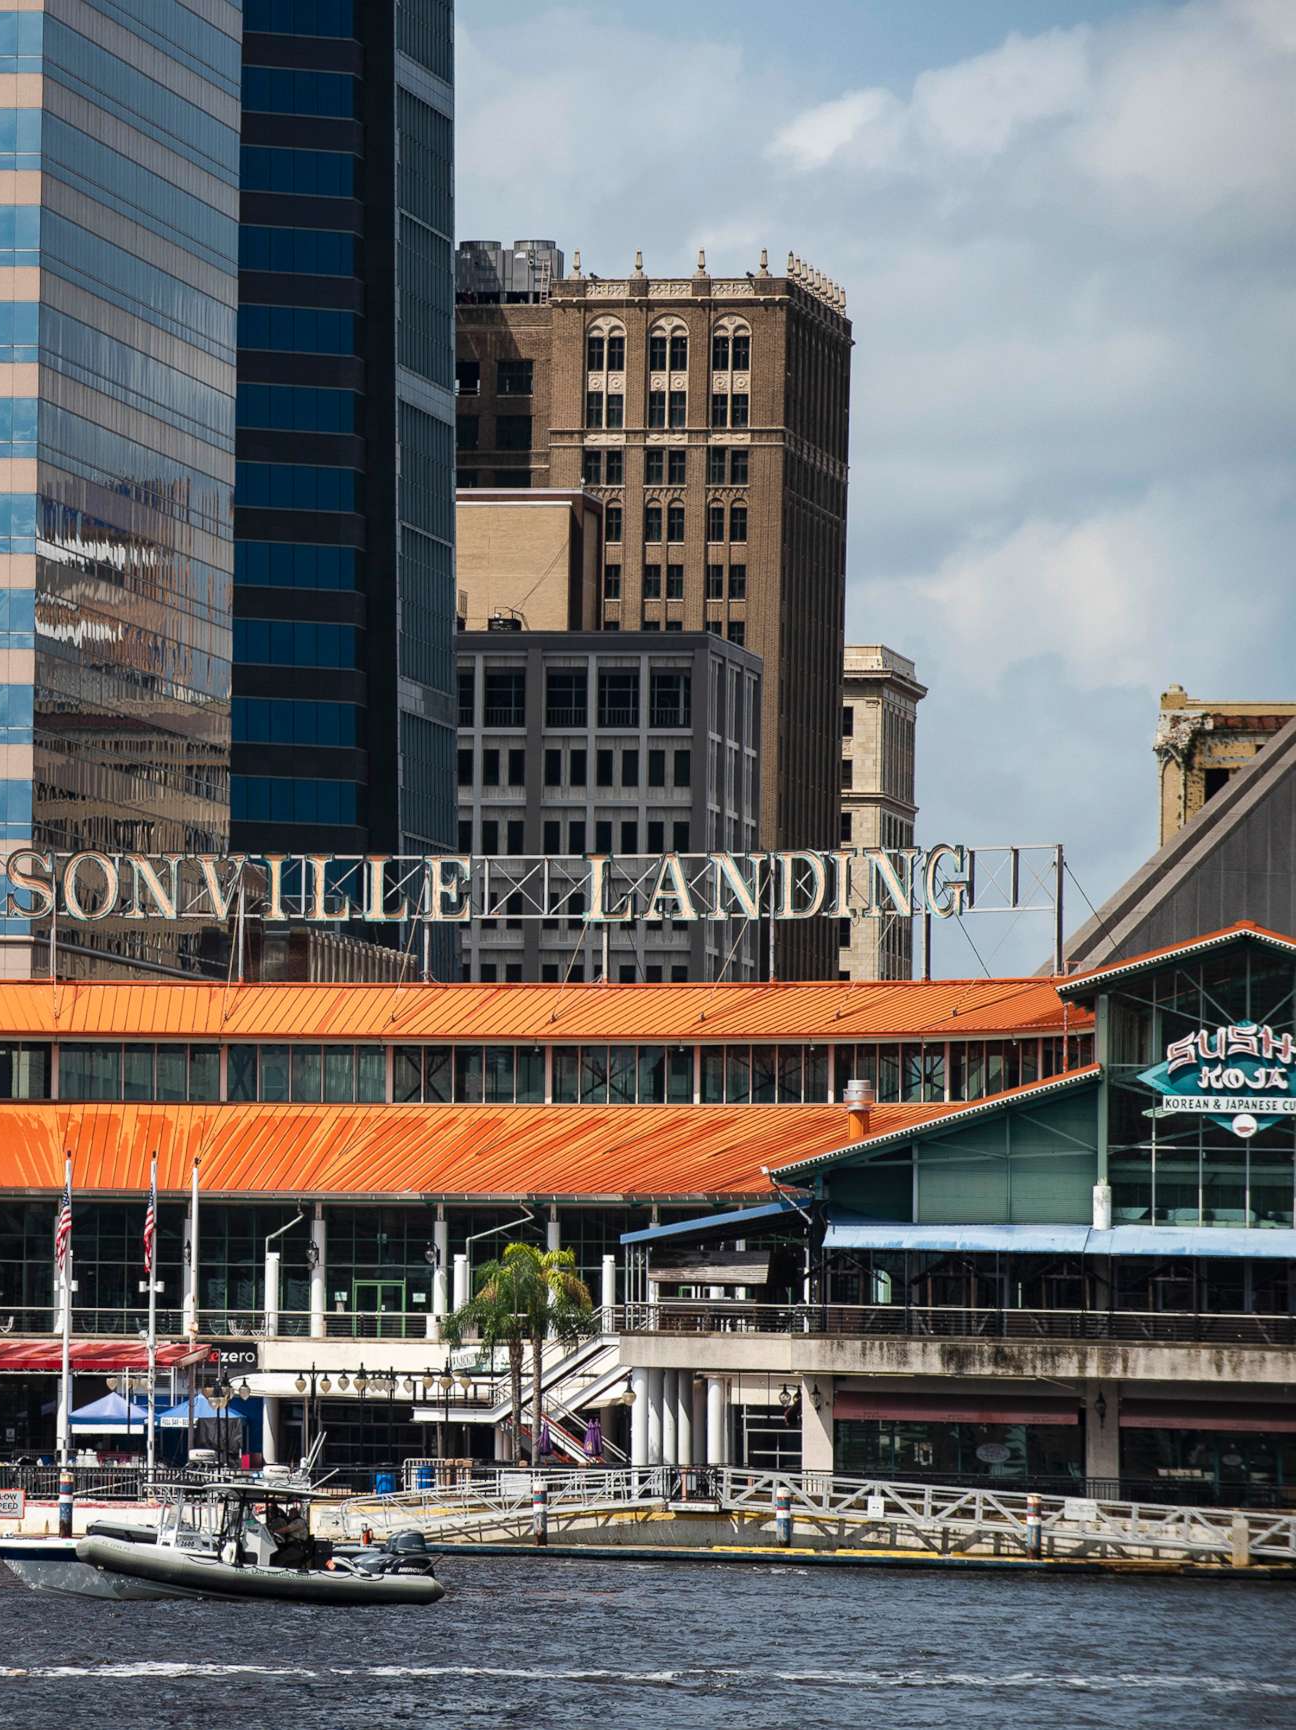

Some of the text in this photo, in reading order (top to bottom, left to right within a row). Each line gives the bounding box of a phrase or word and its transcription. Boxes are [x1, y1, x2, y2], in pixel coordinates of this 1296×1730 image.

[582, 843, 970, 922] LANDING
[1197, 1063, 1289, 1089] KOJA
[1165, 1098, 1210, 1110] KOREAN
[1213, 1099, 1223, 1110] &
[1225, 1099, 1278, 1111] JAPANESE
